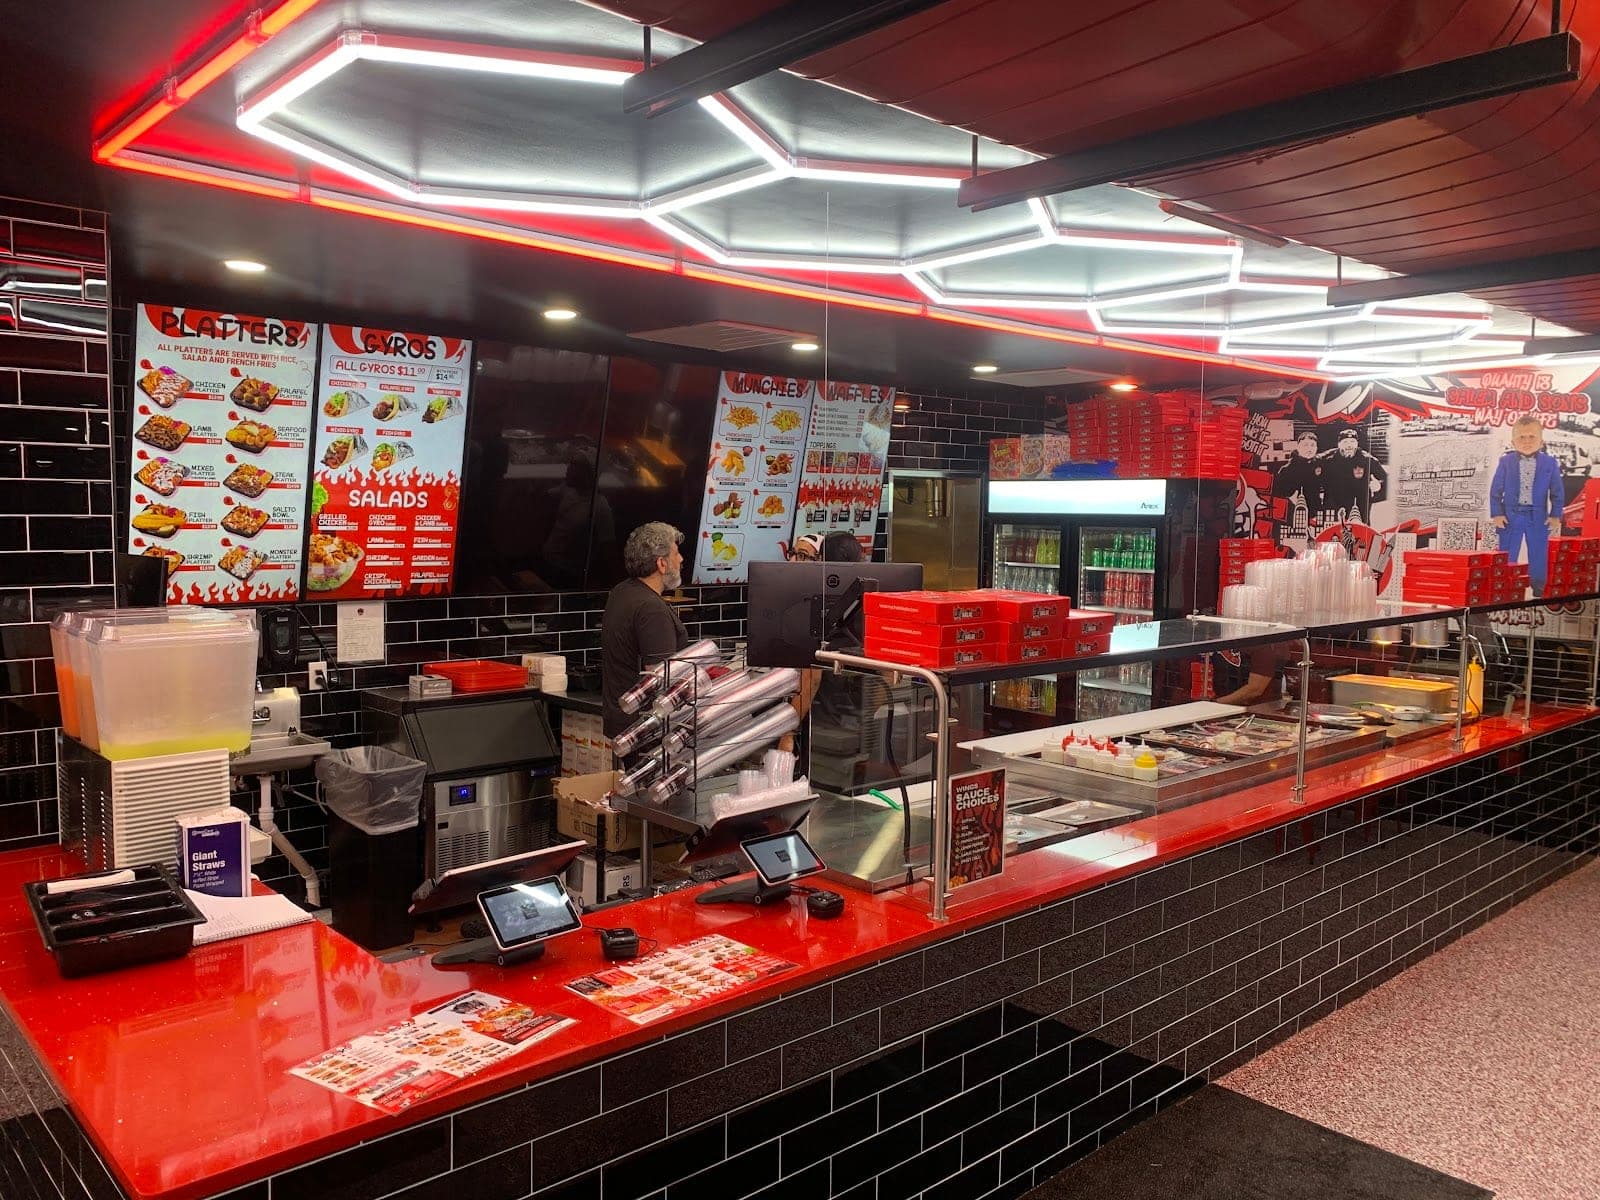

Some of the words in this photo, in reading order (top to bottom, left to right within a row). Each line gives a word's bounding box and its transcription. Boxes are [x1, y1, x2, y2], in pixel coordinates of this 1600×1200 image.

[161, 312, 298, 347] PLATTERS
[157, 343, 172, 352] ALL
[174, 345, 213, 355] PLATTERS
[215, 348, 228, 357] ARE
[231, 350, 259, 360] SERVED
[261, 353, 279, 362] WITH
[364, 333, 436, 360] GYROS
[181, 354, 208, 363] SALAD
[209, 356, 225, 364] AND
[226, 358, 255, 367] FRENCH
[256, 360, 276, 369] FRIES
[336, 361, 357, 372] ALL
[360, 362, 395, 375] GYROS
[195, 381, 226, 389] CHICKEN
[733, 377, 802, 398] MUNCHIES
[1482, 372, 1533, 389] QUALITY
[279, 387, 308, 395] FALAFEL
[828, 385, 883, 403] WAFFLES
[1475, 408, 1503, 426] WAY
[277, 425, 307, 433] SEAFOOD
[348, 490, 428, 509] SALADS
[956, 783, 978, 793] WINGS
[956, 787, 990, 803] SAUCE
[956, 793, 999, 811] CHOICES
[192, 849, 218, 862] Giant
[192, 860, 226, 872] Straws
